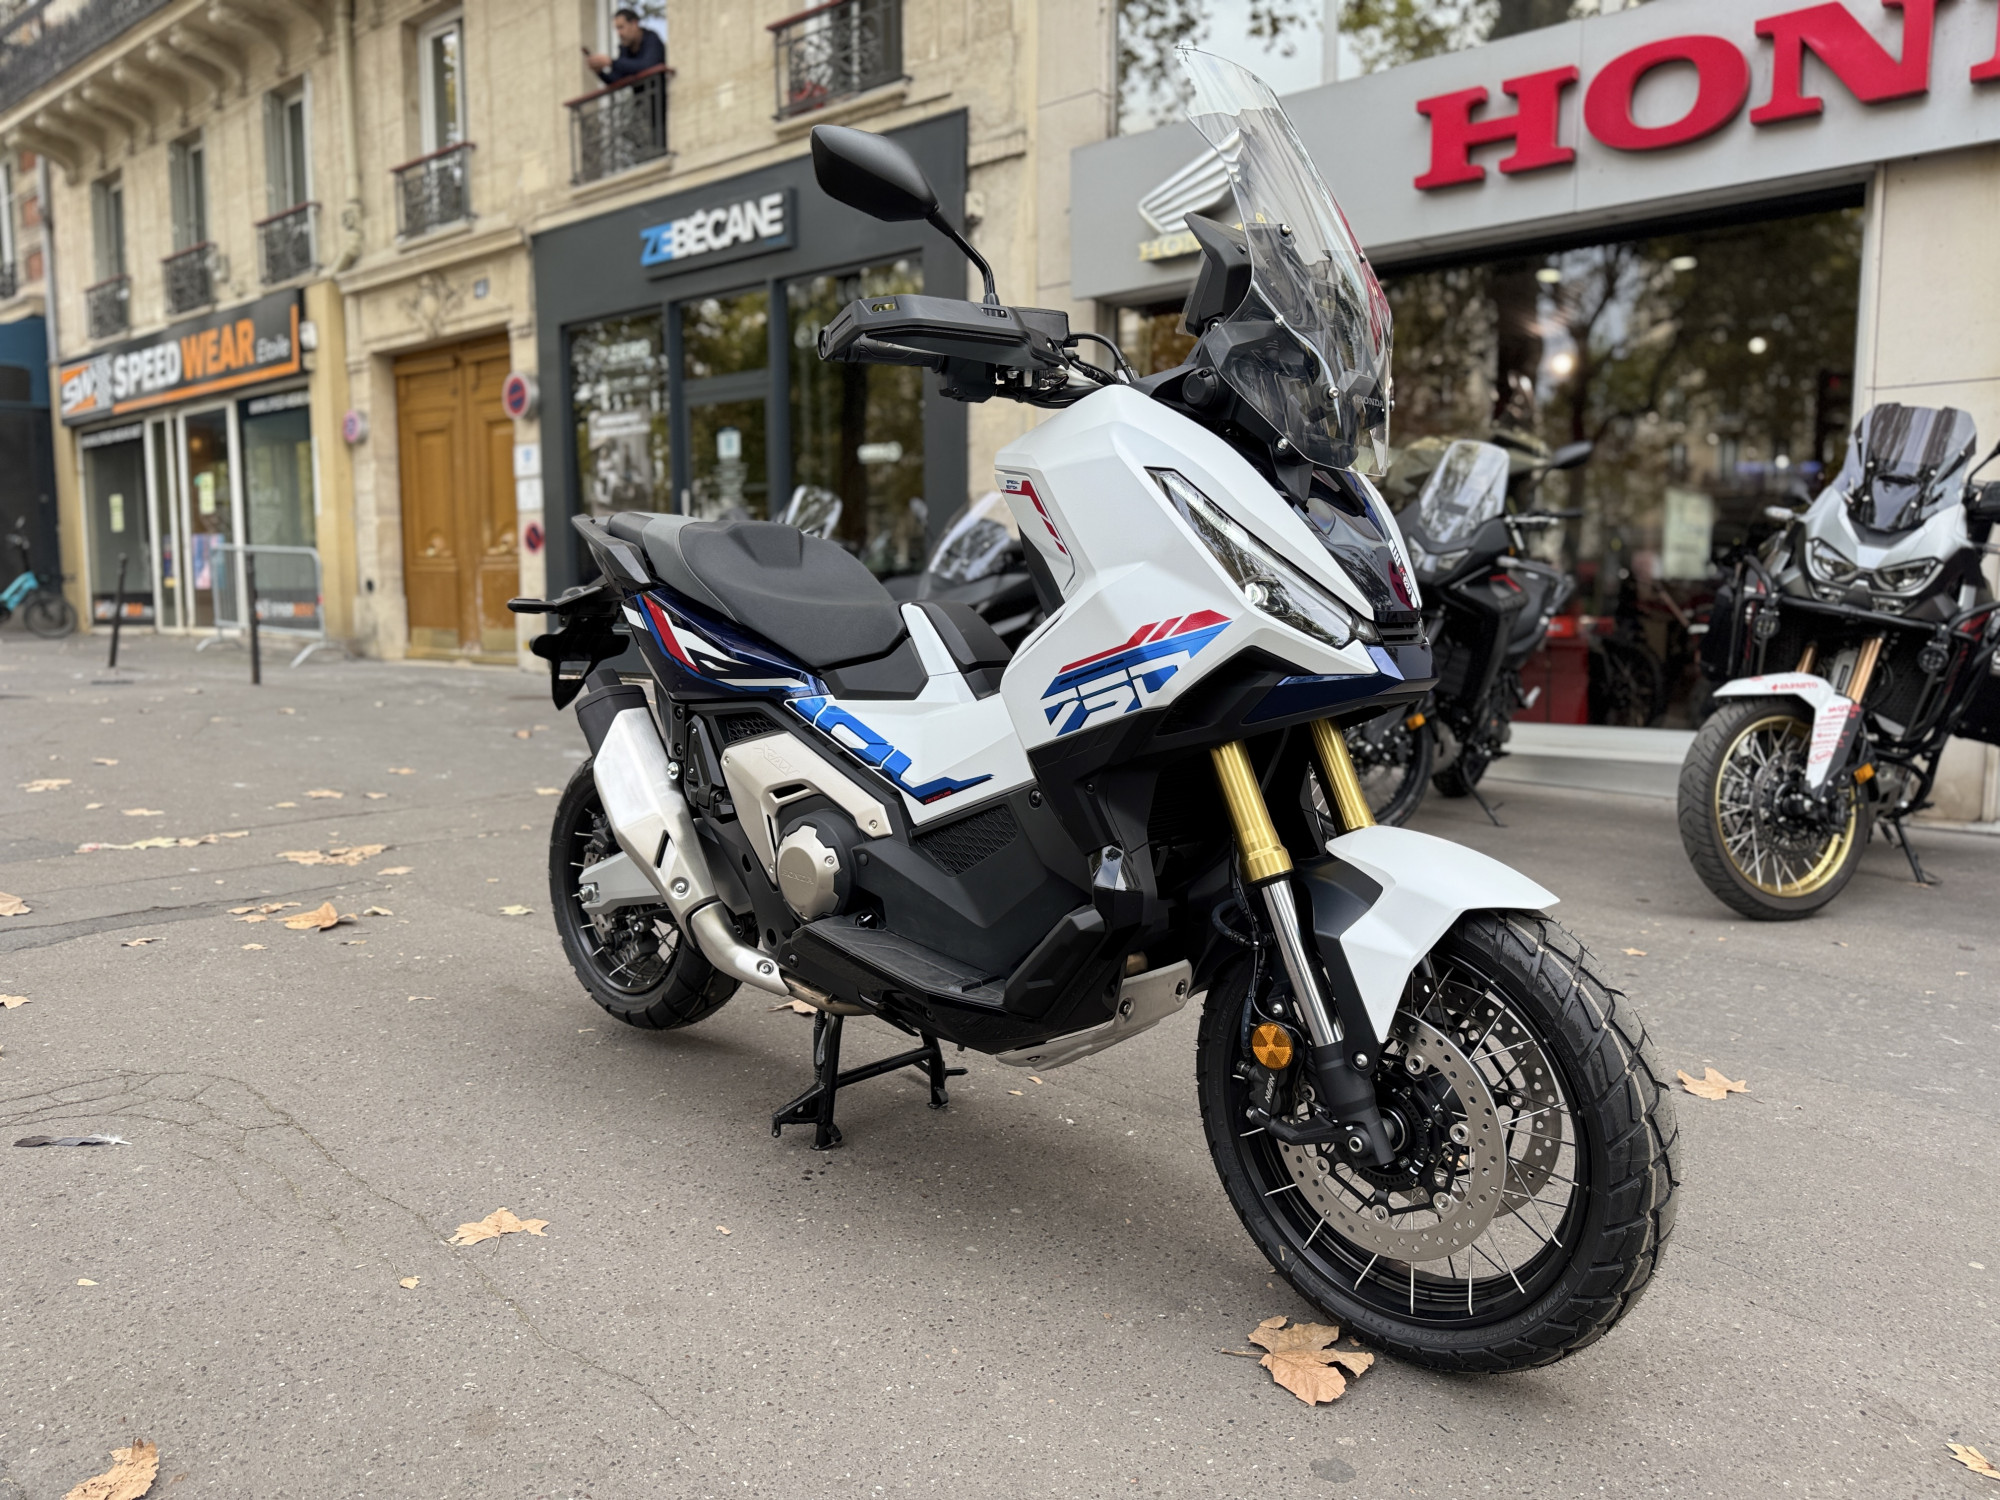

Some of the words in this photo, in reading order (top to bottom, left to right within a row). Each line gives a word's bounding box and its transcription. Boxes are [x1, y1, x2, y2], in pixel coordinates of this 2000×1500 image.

[1414, 0, 2000, 190] HON
[640, 193, 784, 266] ZEBÉCANE
[113, 341, 182, 399] SPEED
[180, 320, 255, 381] WEAR
